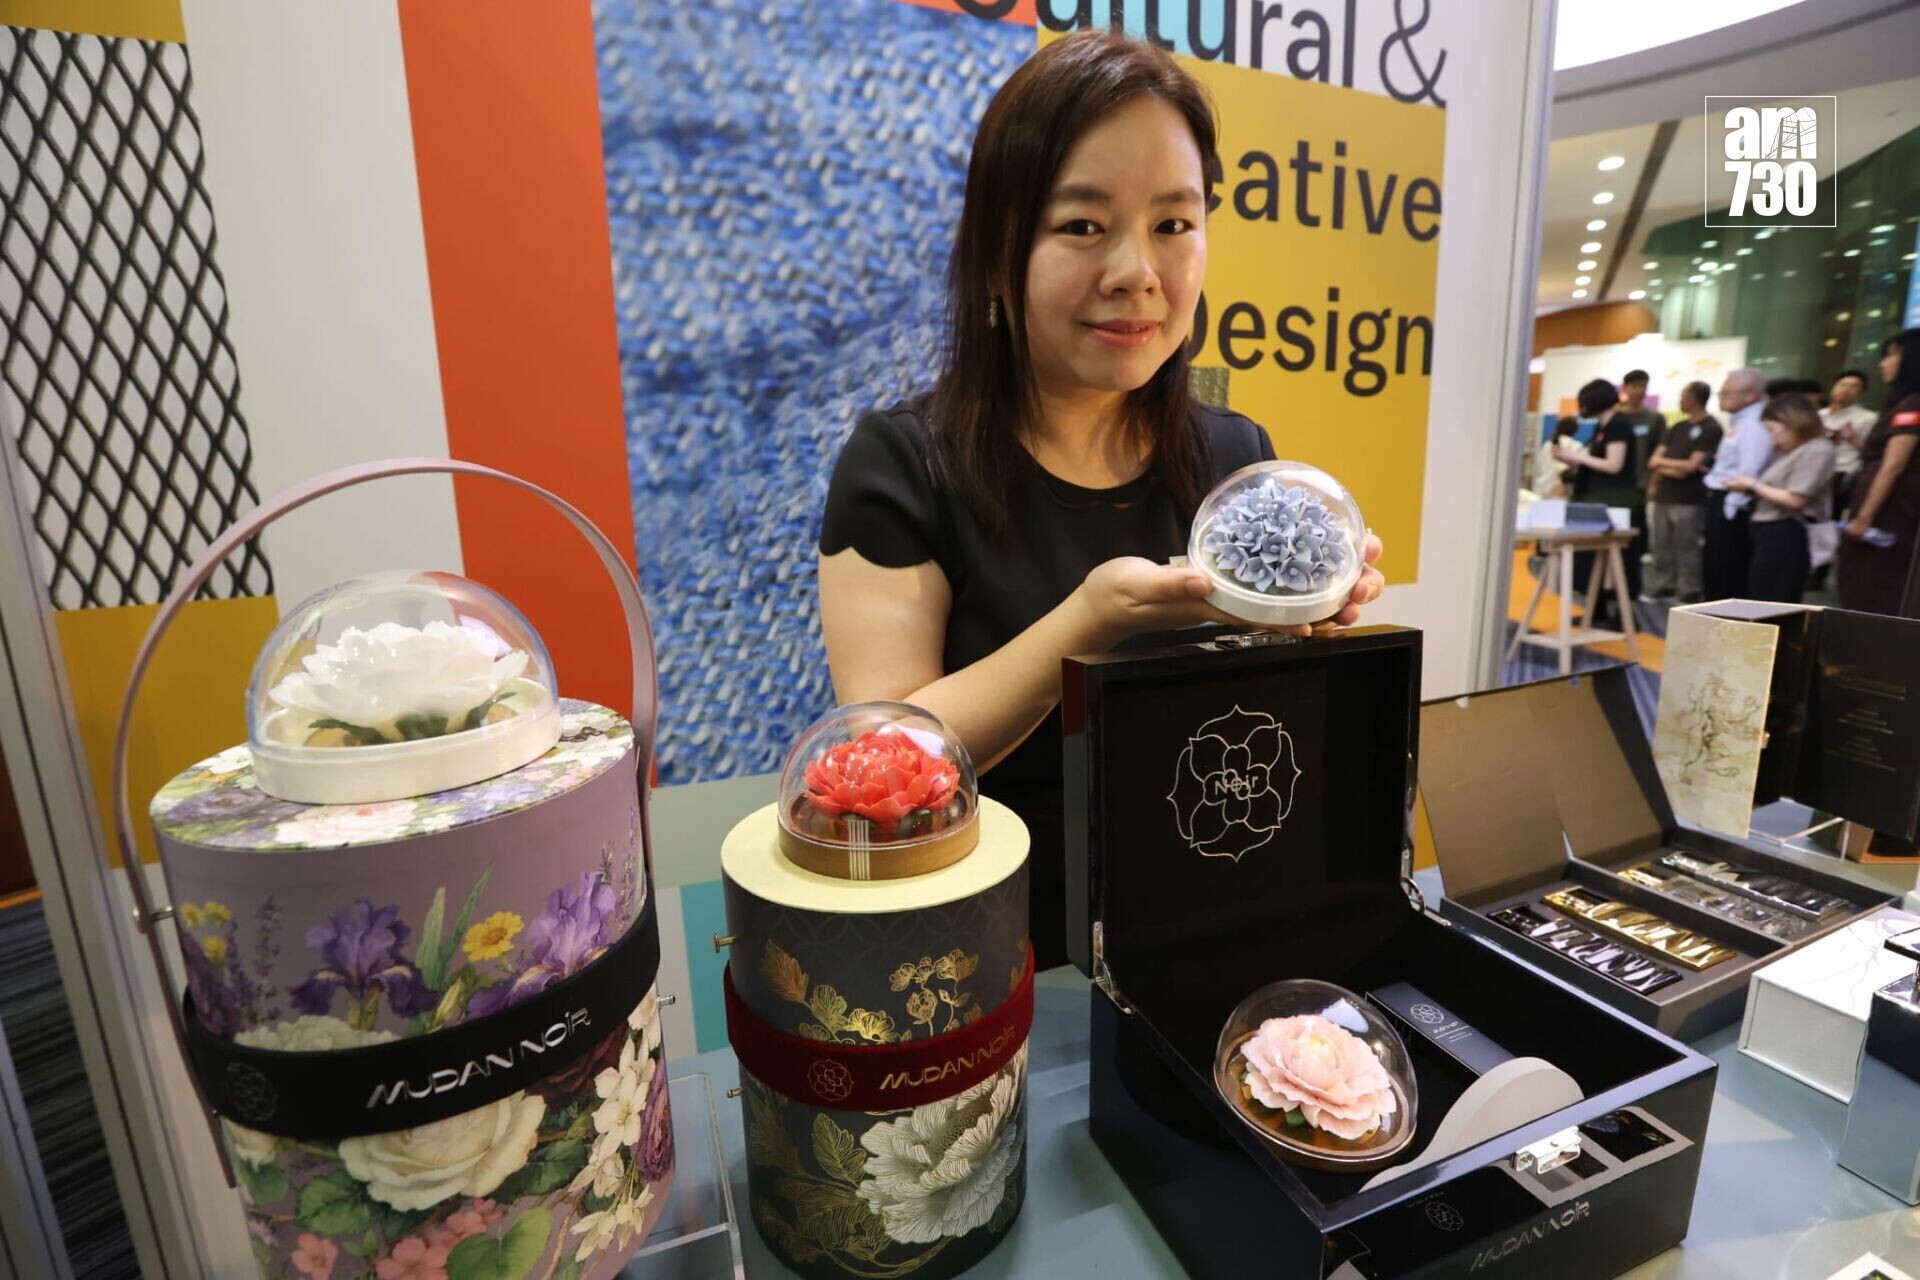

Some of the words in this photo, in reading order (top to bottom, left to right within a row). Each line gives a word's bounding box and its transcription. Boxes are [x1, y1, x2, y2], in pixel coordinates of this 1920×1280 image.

[1379, 0, 1447, 108] &
[366, 1047, 514, 1109] MUDAN
[880, 1052, 975, 1090] MUDAN
